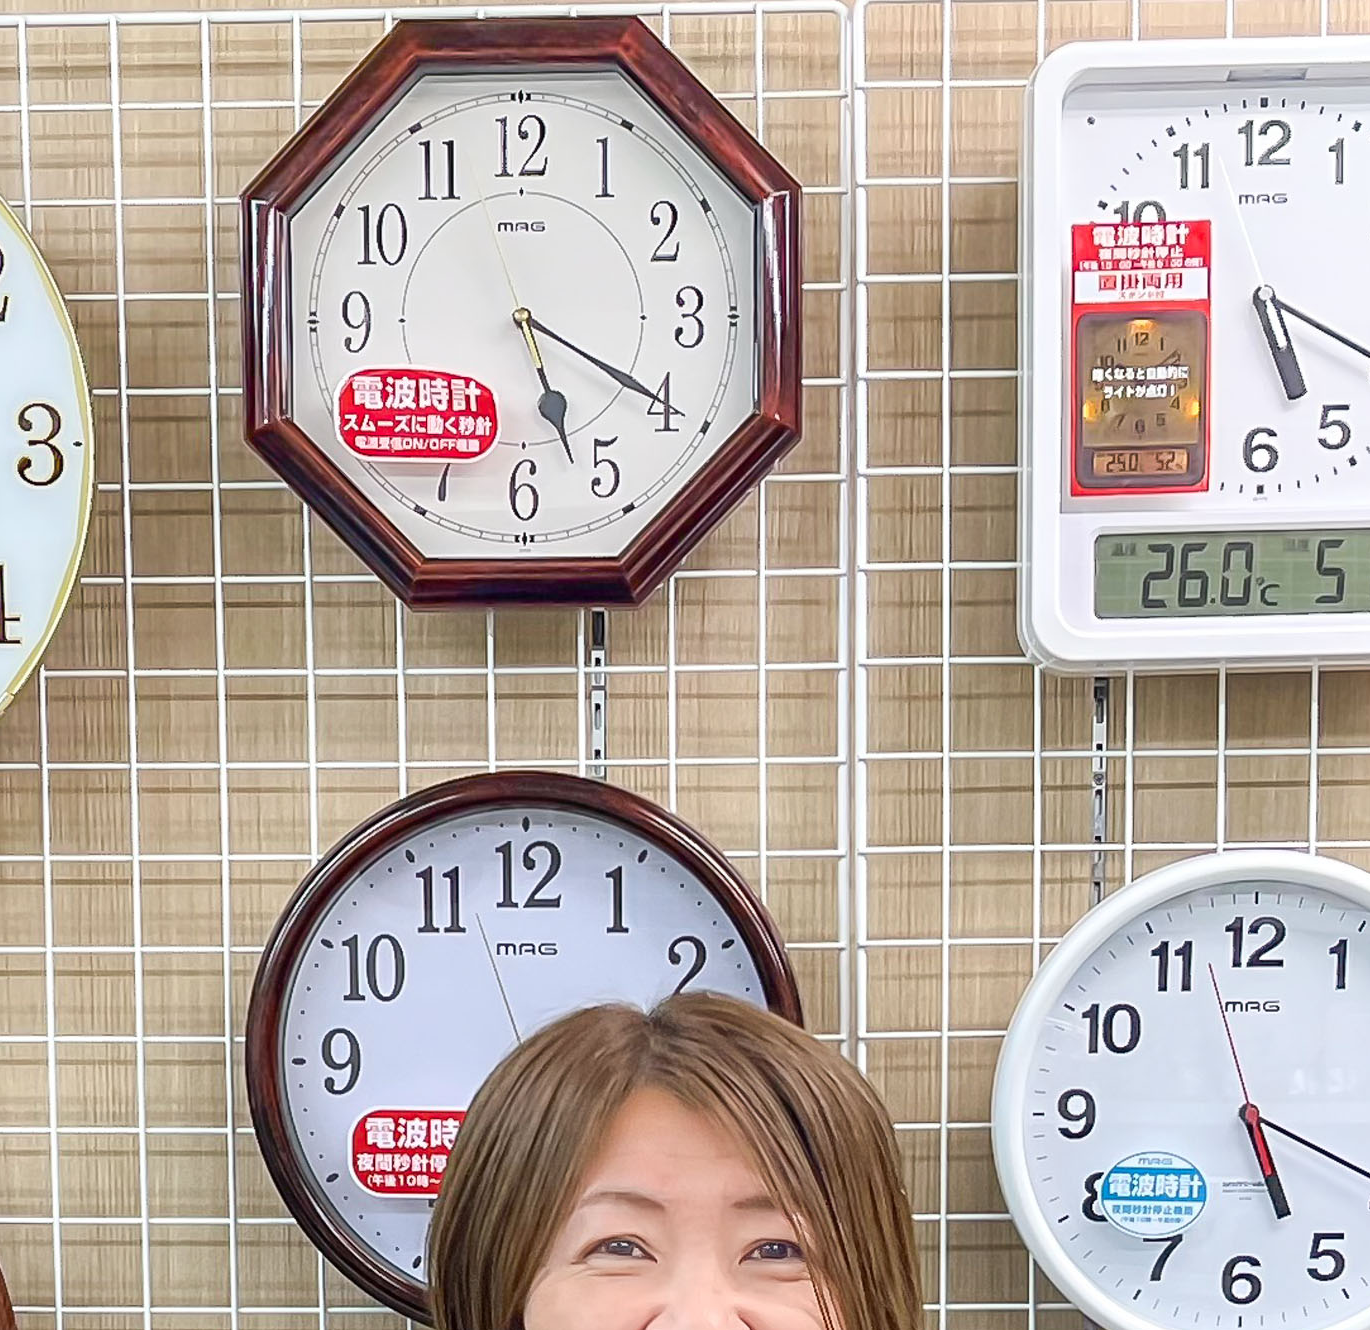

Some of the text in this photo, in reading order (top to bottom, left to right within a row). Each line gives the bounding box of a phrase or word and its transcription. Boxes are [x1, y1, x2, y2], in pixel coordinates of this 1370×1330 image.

[495, 115, 547, 177] 12
[1238, 120, 1291, 166] 12
[419, 140, 460, 200] 11
[1239, 193, 1288, 205] MAG
[358, 204, 407, 265] 10
[498, 221, 545, 232] MAG
[651, 201, 679, 262] 2
[1092, 224, 1190, 247] 電波時計
[352, 377, 481, 411] 電波時計
[344, 414, 492, 436] スムーズに動く秒針
[1318, 405, 1350, 449] 5
[1243, 428, 1278, 472] 6
[495, 841, 561, 908] 12
[416, 866, 466, 933] 11
[496, 942, 558, 956] MAG
[1225, 917, 1285, 967] 12
[342, 935, 404, 1001] 10
[1082, 1004, 1140, 1053] 10
[1225, 1001, 1280, 1012] MAG
[322, 1028, 360, 1095] 9
[1108, 1173, 1202, 1198] 電波時計
[1222, 1256, 1261, 1304] 6
